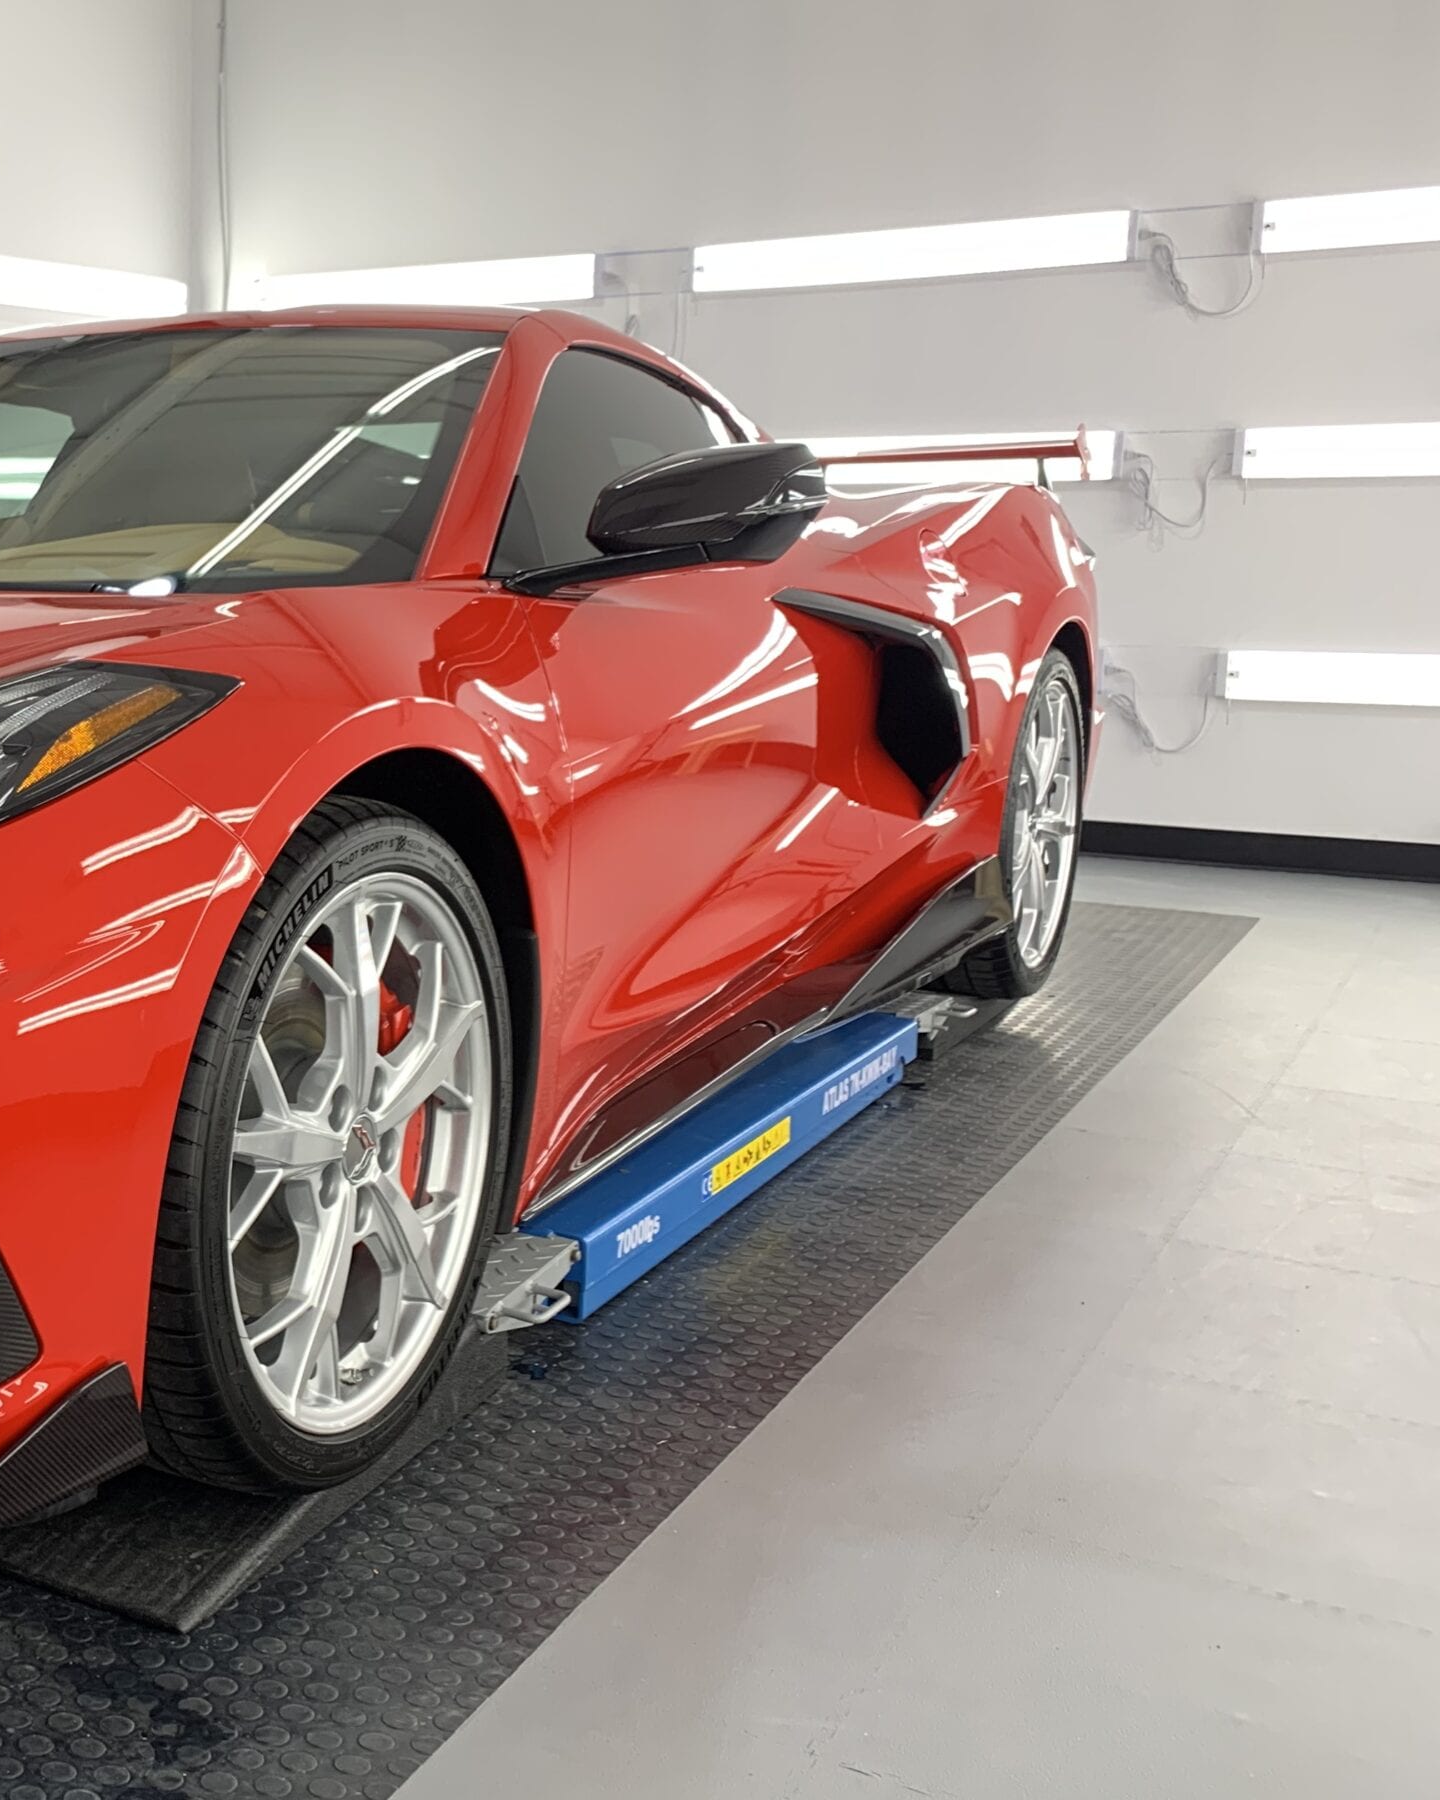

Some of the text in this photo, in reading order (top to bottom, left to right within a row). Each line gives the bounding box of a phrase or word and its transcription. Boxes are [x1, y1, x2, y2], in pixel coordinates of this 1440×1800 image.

[257, 869, 331, 993] MICHELIN
[822, 1077, 849, 1116] ATLAS
[616, 1215, 661, 1259] 7000lbs
